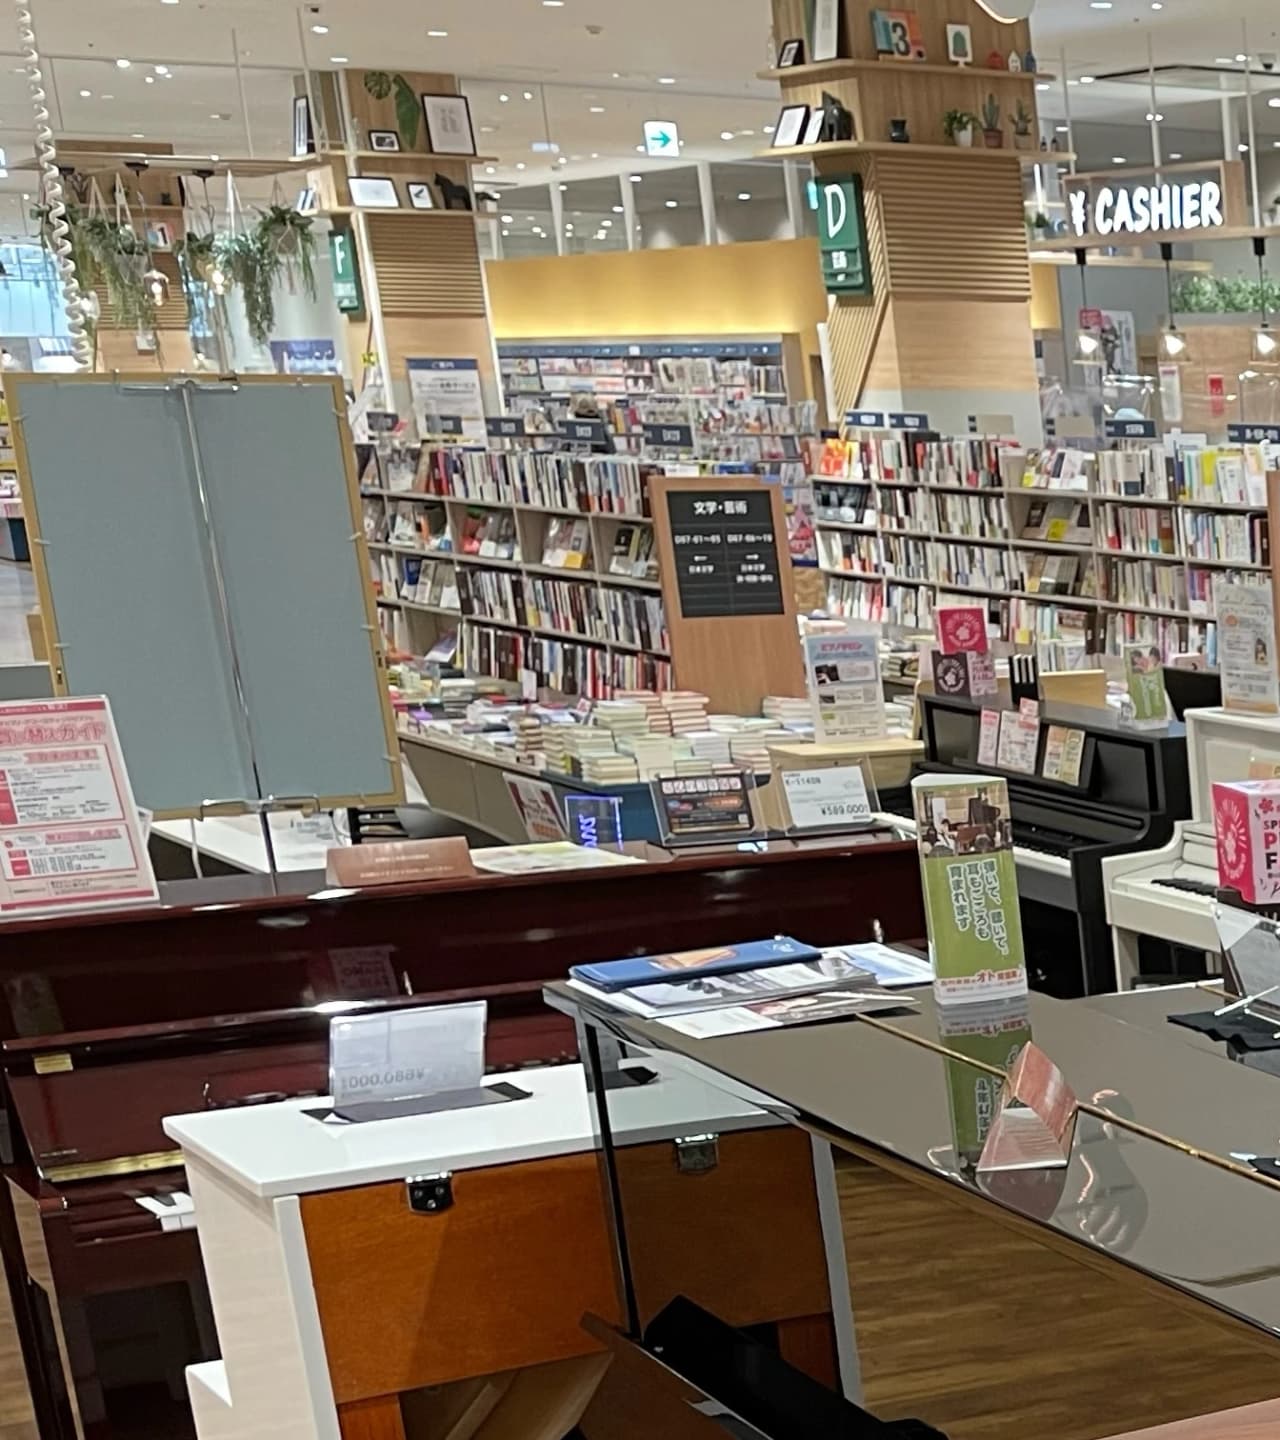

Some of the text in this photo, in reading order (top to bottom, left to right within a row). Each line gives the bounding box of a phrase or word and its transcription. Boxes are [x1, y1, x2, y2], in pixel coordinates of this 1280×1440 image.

[824, 184, 847, 238] D
[1095, 181, 1223, 235] CASHIER
[947, 864, 970, 931] 育まれます
[966, 861, 990, 941] 耳もこころも
